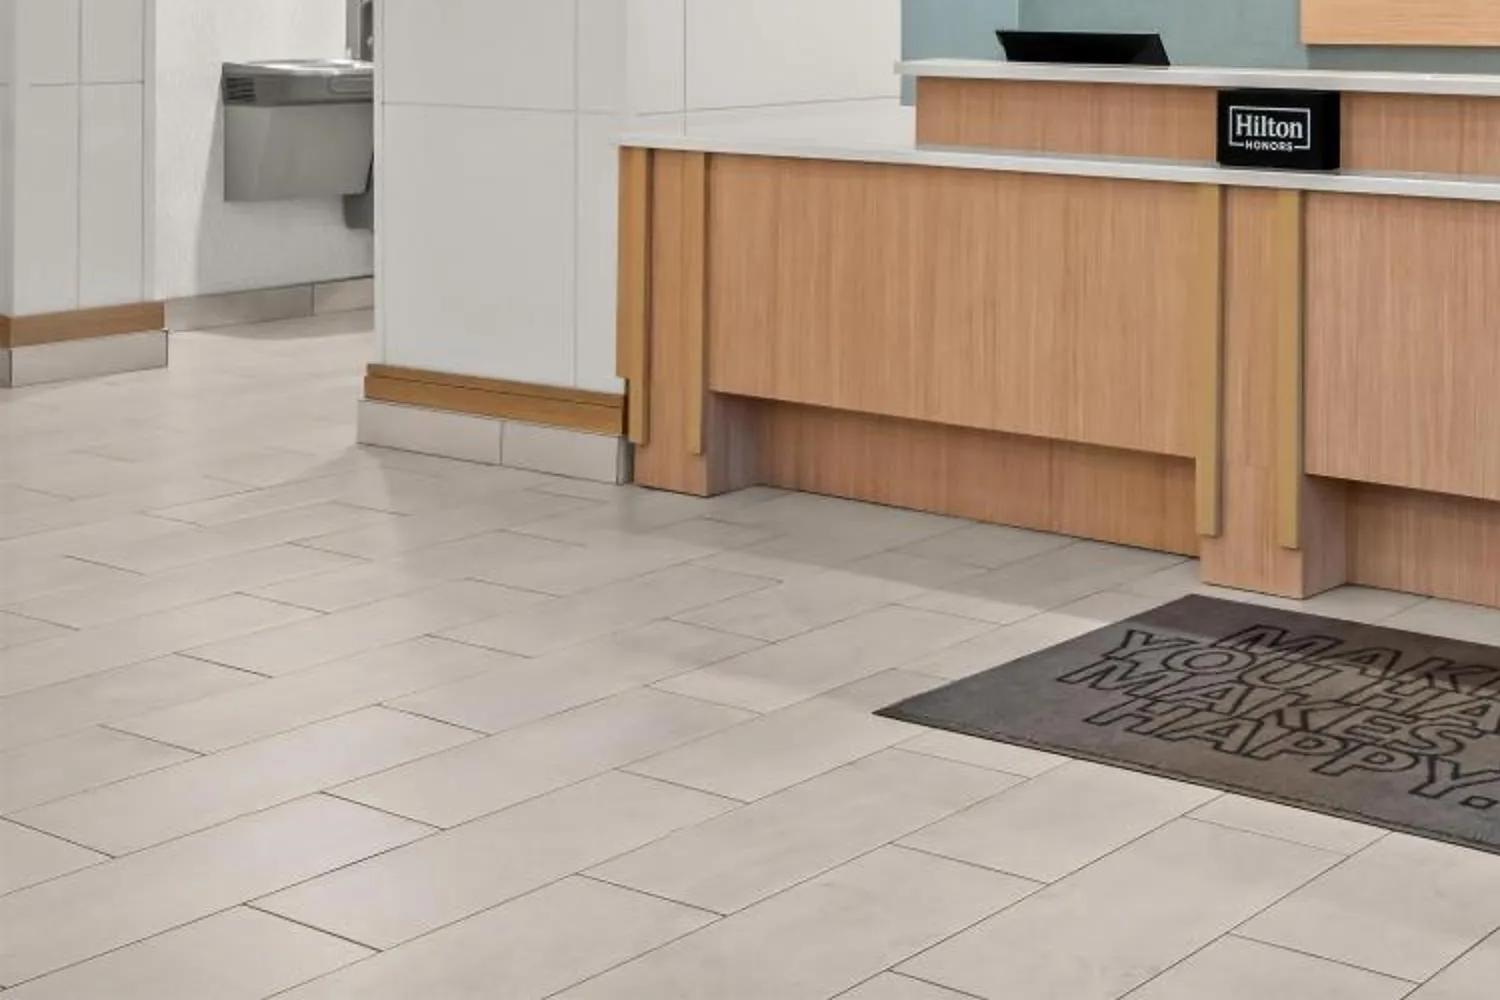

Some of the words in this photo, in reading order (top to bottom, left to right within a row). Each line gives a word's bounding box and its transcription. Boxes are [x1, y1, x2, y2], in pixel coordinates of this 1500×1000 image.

[1235, 113, 1304, 139] Hilton
[1245, 140, 1293, 151] HONORS
[1103, 628, 1344, 691] YOU
[1055, 658, 1482, 753] MAKES
